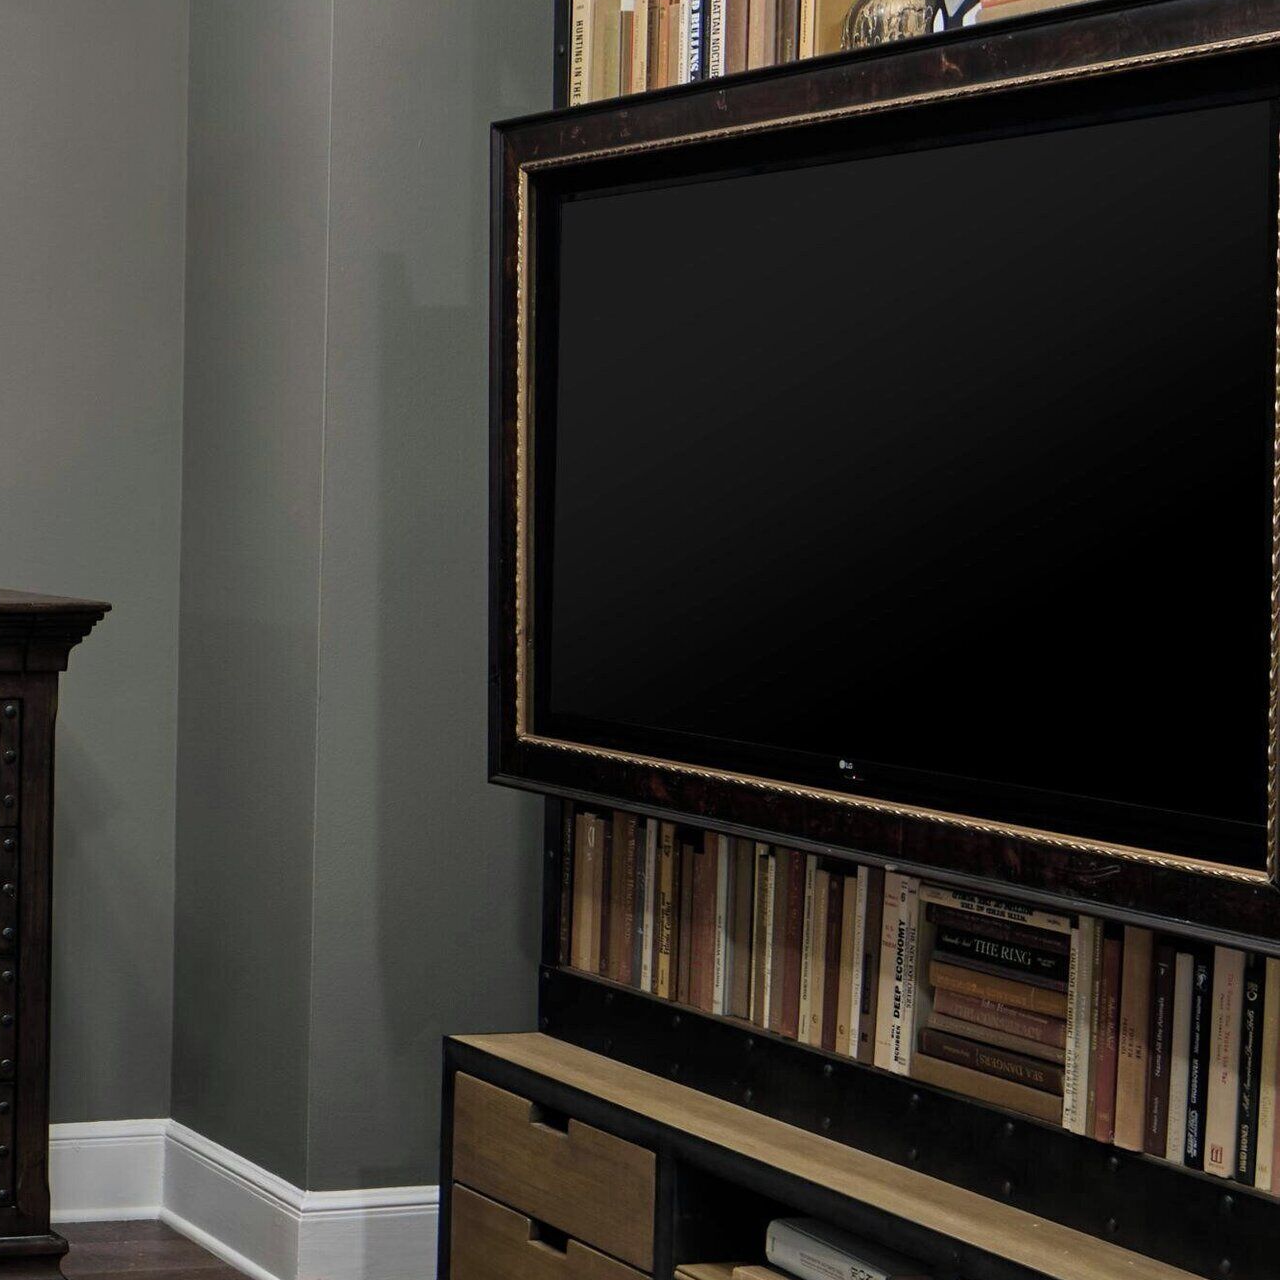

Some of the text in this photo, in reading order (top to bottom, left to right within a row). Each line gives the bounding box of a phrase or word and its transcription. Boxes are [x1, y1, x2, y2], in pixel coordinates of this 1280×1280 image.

[575, 21, 583, 64] HUNTING
[711, 39, 720, 78] NOCTUR
[575, 67, 582, 77] IN
[893, 920, 905, 1018] DEEP ECONOMY
[975, 939, 998, 957] THE
[1001, 946, 1031, 966] RING
[1191, 1058, 1199, 1103] CROSSOVER
